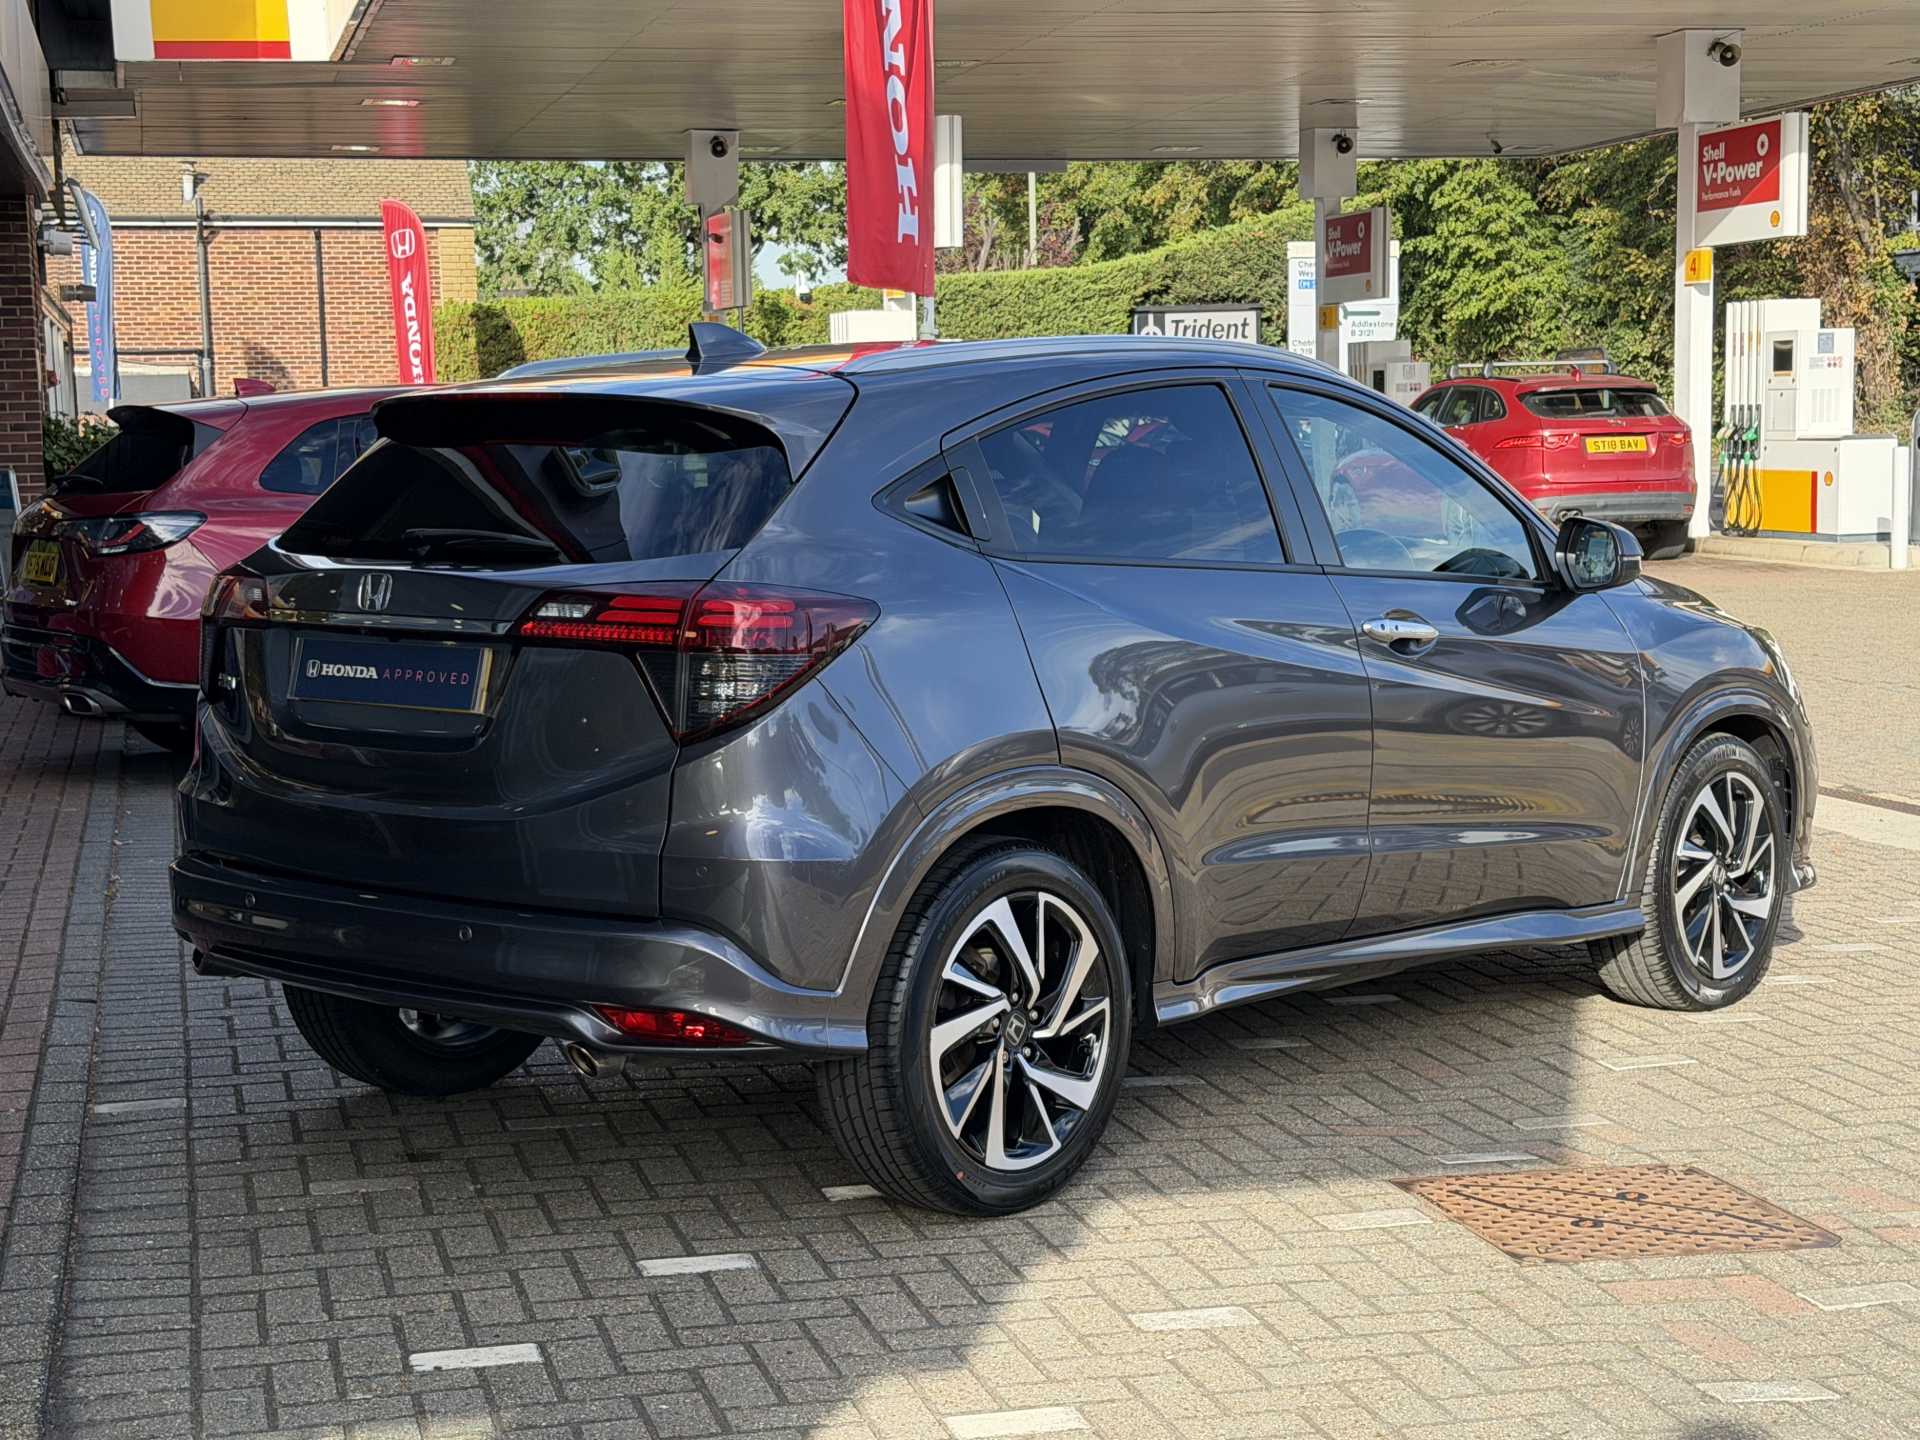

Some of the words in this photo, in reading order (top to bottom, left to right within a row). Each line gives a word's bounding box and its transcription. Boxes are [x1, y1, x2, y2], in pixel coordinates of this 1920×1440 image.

[1702, 142, 1725, 162] Shell
[1690, 257, 1697, 276] 4
[1171, 317, 1249, 339] Trident
[1351, 320, 1394, 328] Addlestone
[1593, 440, 1617, 451] ST18
[1619, 439, 1638, 450] BAV
[320, 663, 379, 679] HONDA
[382, 669, 470, 685] APPROVED
